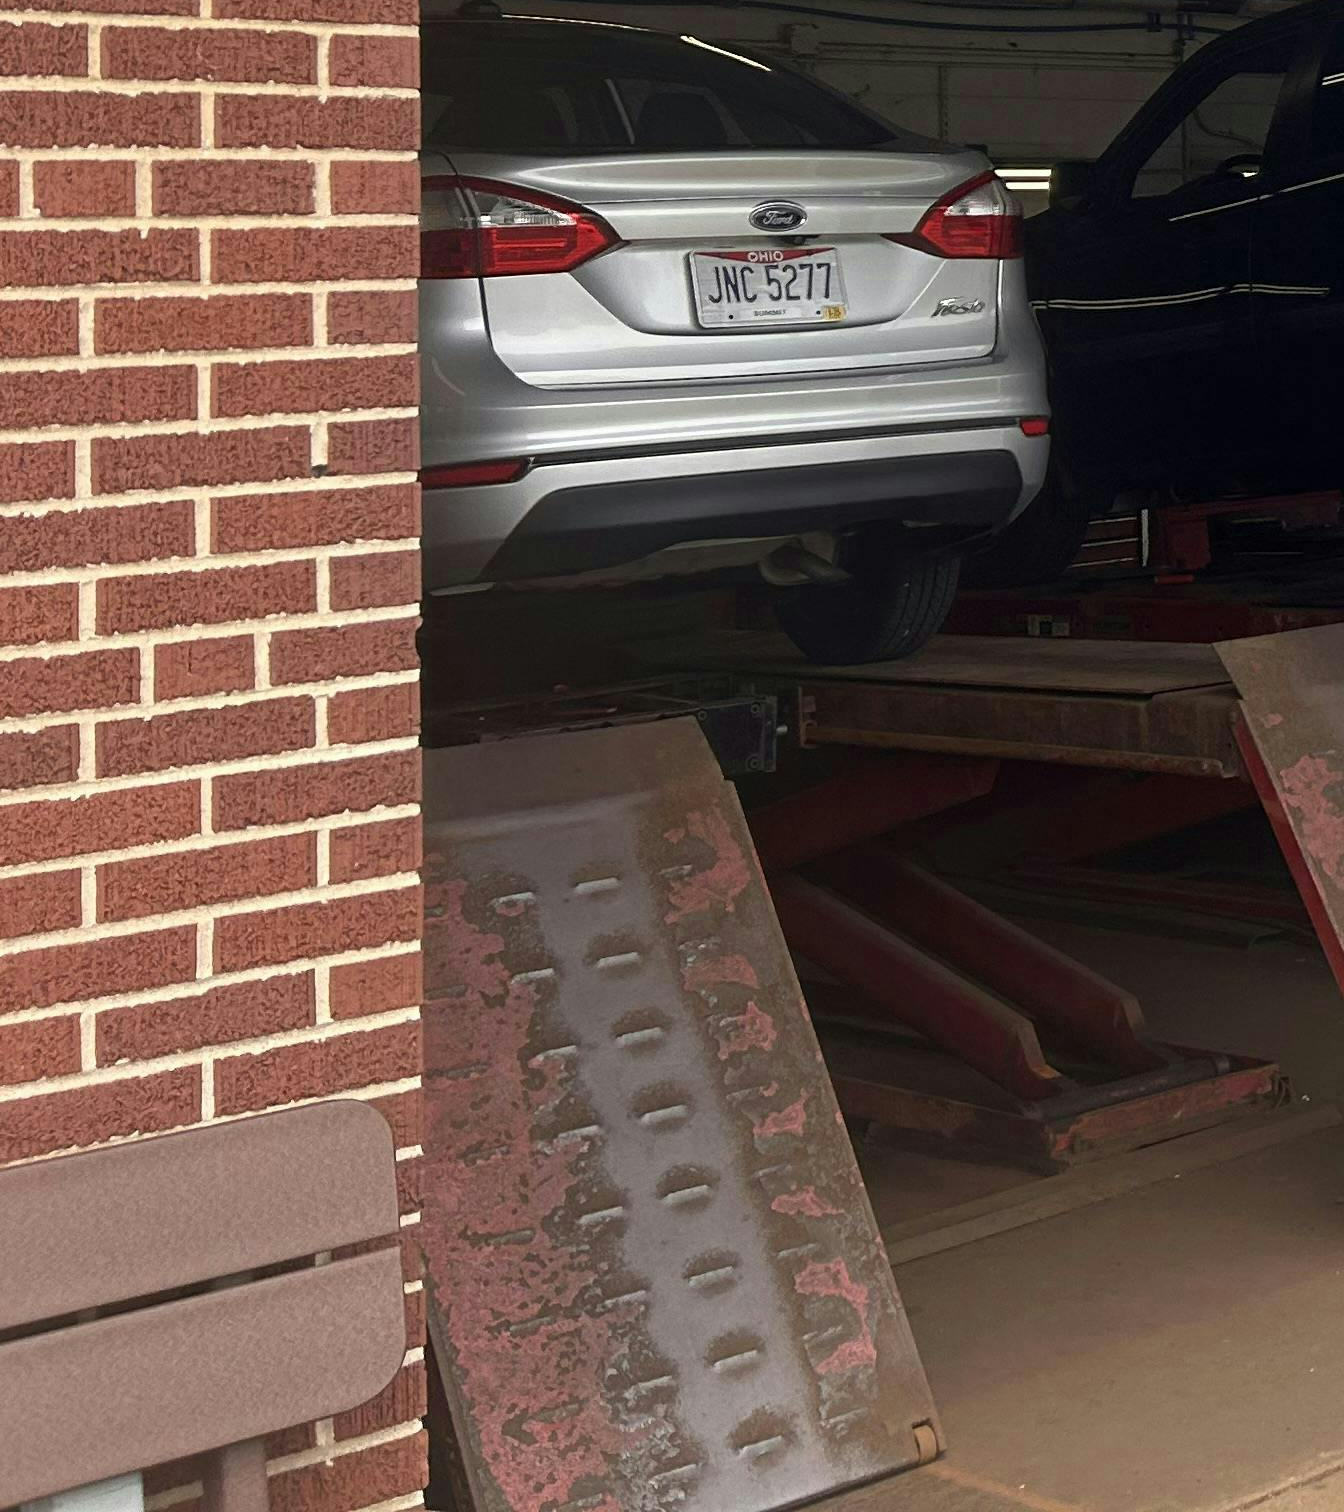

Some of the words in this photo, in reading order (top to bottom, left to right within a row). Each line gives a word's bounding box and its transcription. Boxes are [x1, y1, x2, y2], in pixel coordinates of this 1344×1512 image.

[747, 250, 784, 263] OHIO
[708, 265, 755, 305] JNC
[764, 262, 832, 302] 5277
